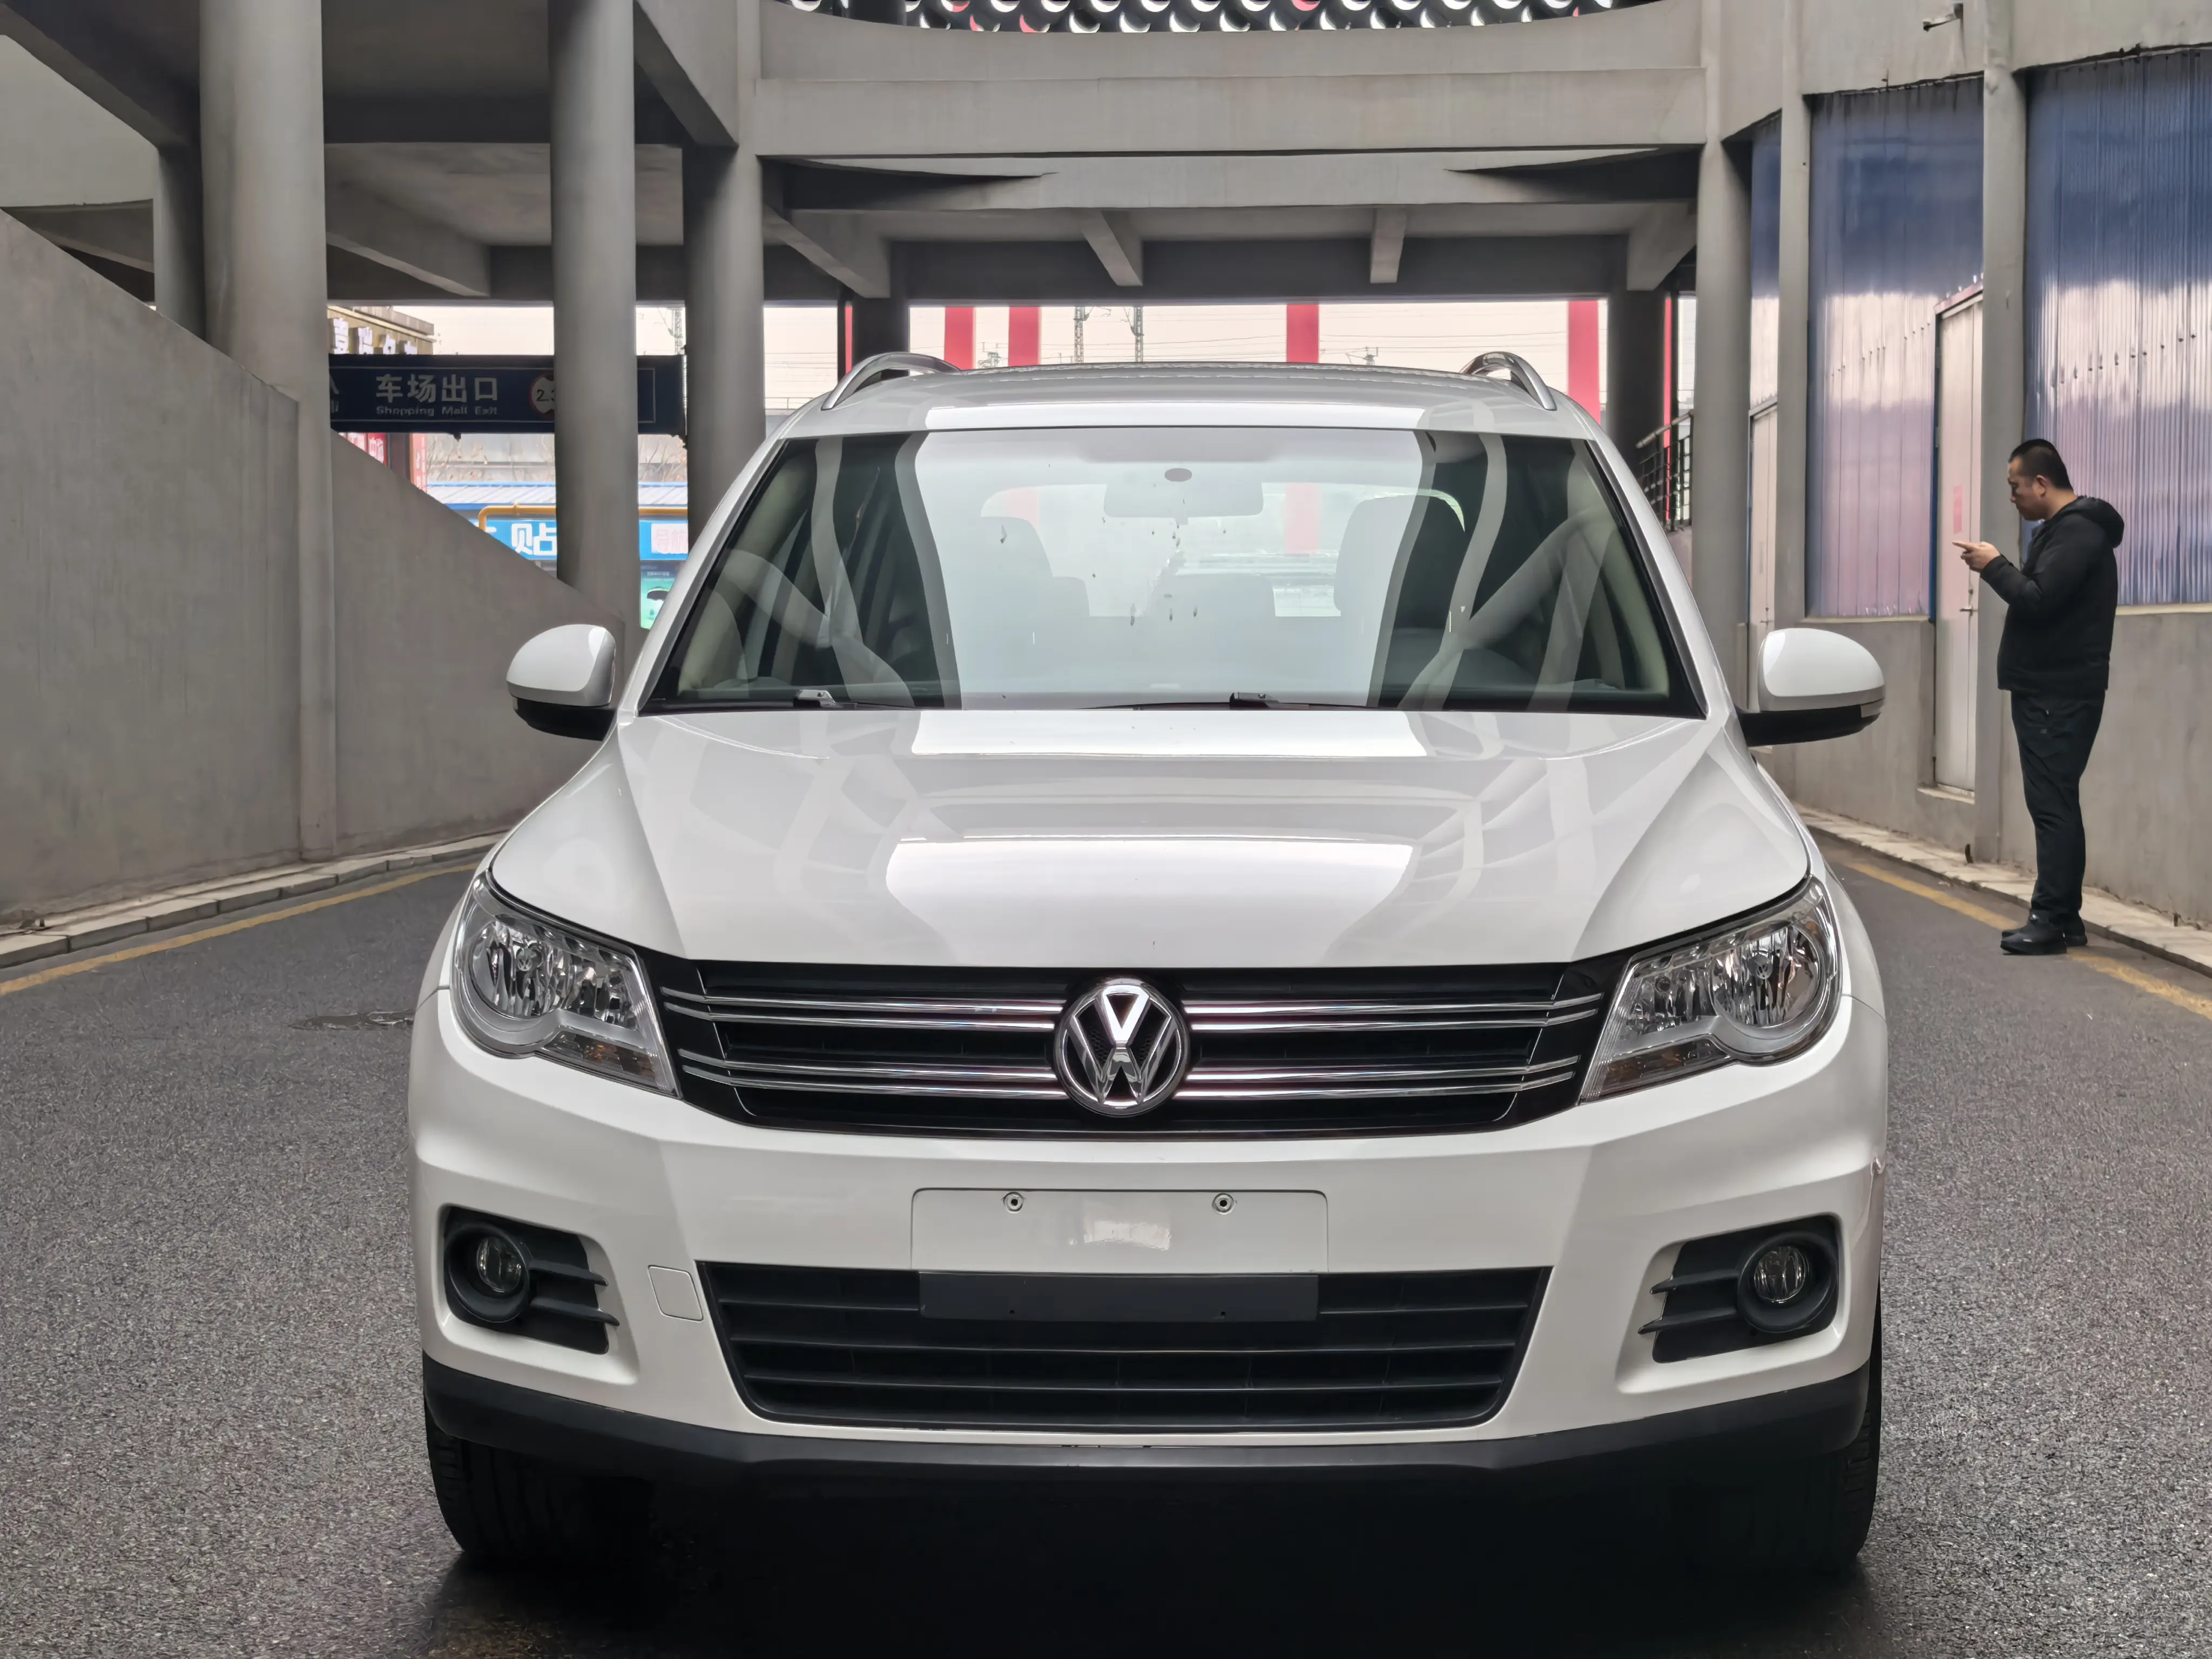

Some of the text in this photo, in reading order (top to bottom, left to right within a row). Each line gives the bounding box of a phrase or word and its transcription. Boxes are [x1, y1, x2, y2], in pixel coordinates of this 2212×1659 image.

[376, 374, 498, 403] 车场出口
[376, 406, 434, 417] Shopping
[441, 406, 468, 415] Mall
